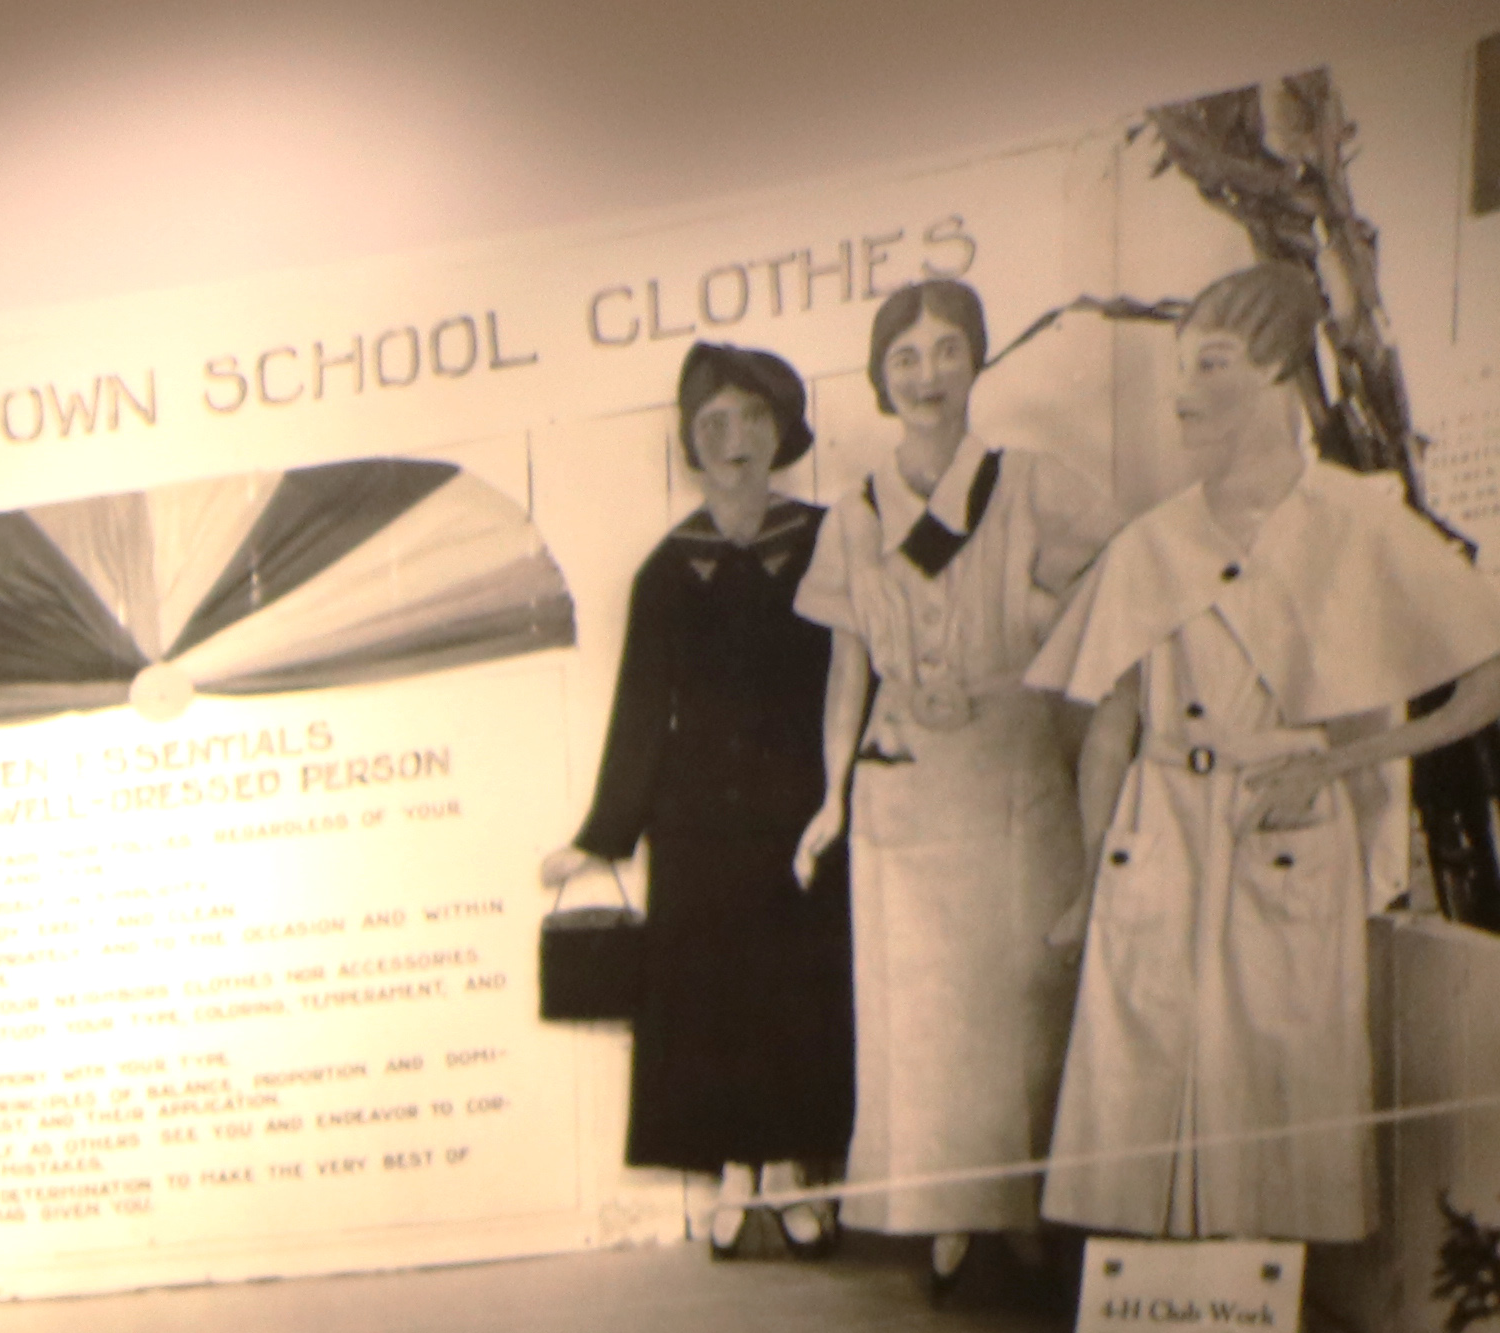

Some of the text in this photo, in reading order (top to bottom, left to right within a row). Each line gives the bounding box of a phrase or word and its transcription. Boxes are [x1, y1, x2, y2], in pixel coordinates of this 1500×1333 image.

[200, 307, 538, 418] SCHOOL
[586, 213, 981, 350] CLOTHES
[299, 746, 452, 794] PERSON
[214, 813, 347, 845] REGARDLESS
[361, 809, 383, 829] OF
[403, 800, 461, 823] YOUR
[5, 869, 39, 888] AND
[66, 892, 80, 909] IN
[101, 939, 137, 958] AND
[154, 935, 174, 952] TO
[190, 930, 224, 949] THE
[243, 916, 344, 944] OCCASION
[360, 908, 405, 932] AND
[422, 897, 502, 924] WITHIN
[116, 910, 153, 930] AND
[184, 971, 271, 997] CLOTHES
[286, 965, 323, 985] NOR
[66, 1014, 113, 1035] YOUR
[464, 973, 504, 994] AND
[63, 1063, 104, 1082] WITH
[119, 1057, 165, 1077] YOUR
[112, 1085, 129, 1102] OF
[253, 1061, 366, 1089] PROPORTION
[383, 1055, 423, 1075] AND
[30, 1140, 50, 1157] AS
[65, 1131, 139, 1153] OTHERS
[161, 1126, 195, 1144] SEE
[213, 1120, 250, 1139] YOU
[265, 1115, 301, 1134] AND
[315, 1103, 417, 1129] ENDEAVOR
[430, 1100, 452, 1118] TO
[39, 1111, 72, 1129] AND
[88, 1104, 142, 1124] THEIR
[0, 1175, 151, 1206] DETERMINATION
[166, 1171, 189, 1190] TO
[199, 1165, 252, 1187] MAKE
[268, 1161, 301, 1180] THE
[316, 1154, 364, 1176] VERY
[381, 1148, 431, 1170] BEST
[444, 1144, 468, 1164] OF
[41, 1200, 98, 1221] GIVEN
[1103, 1300, 1275, 1327] 4-H Club Work
